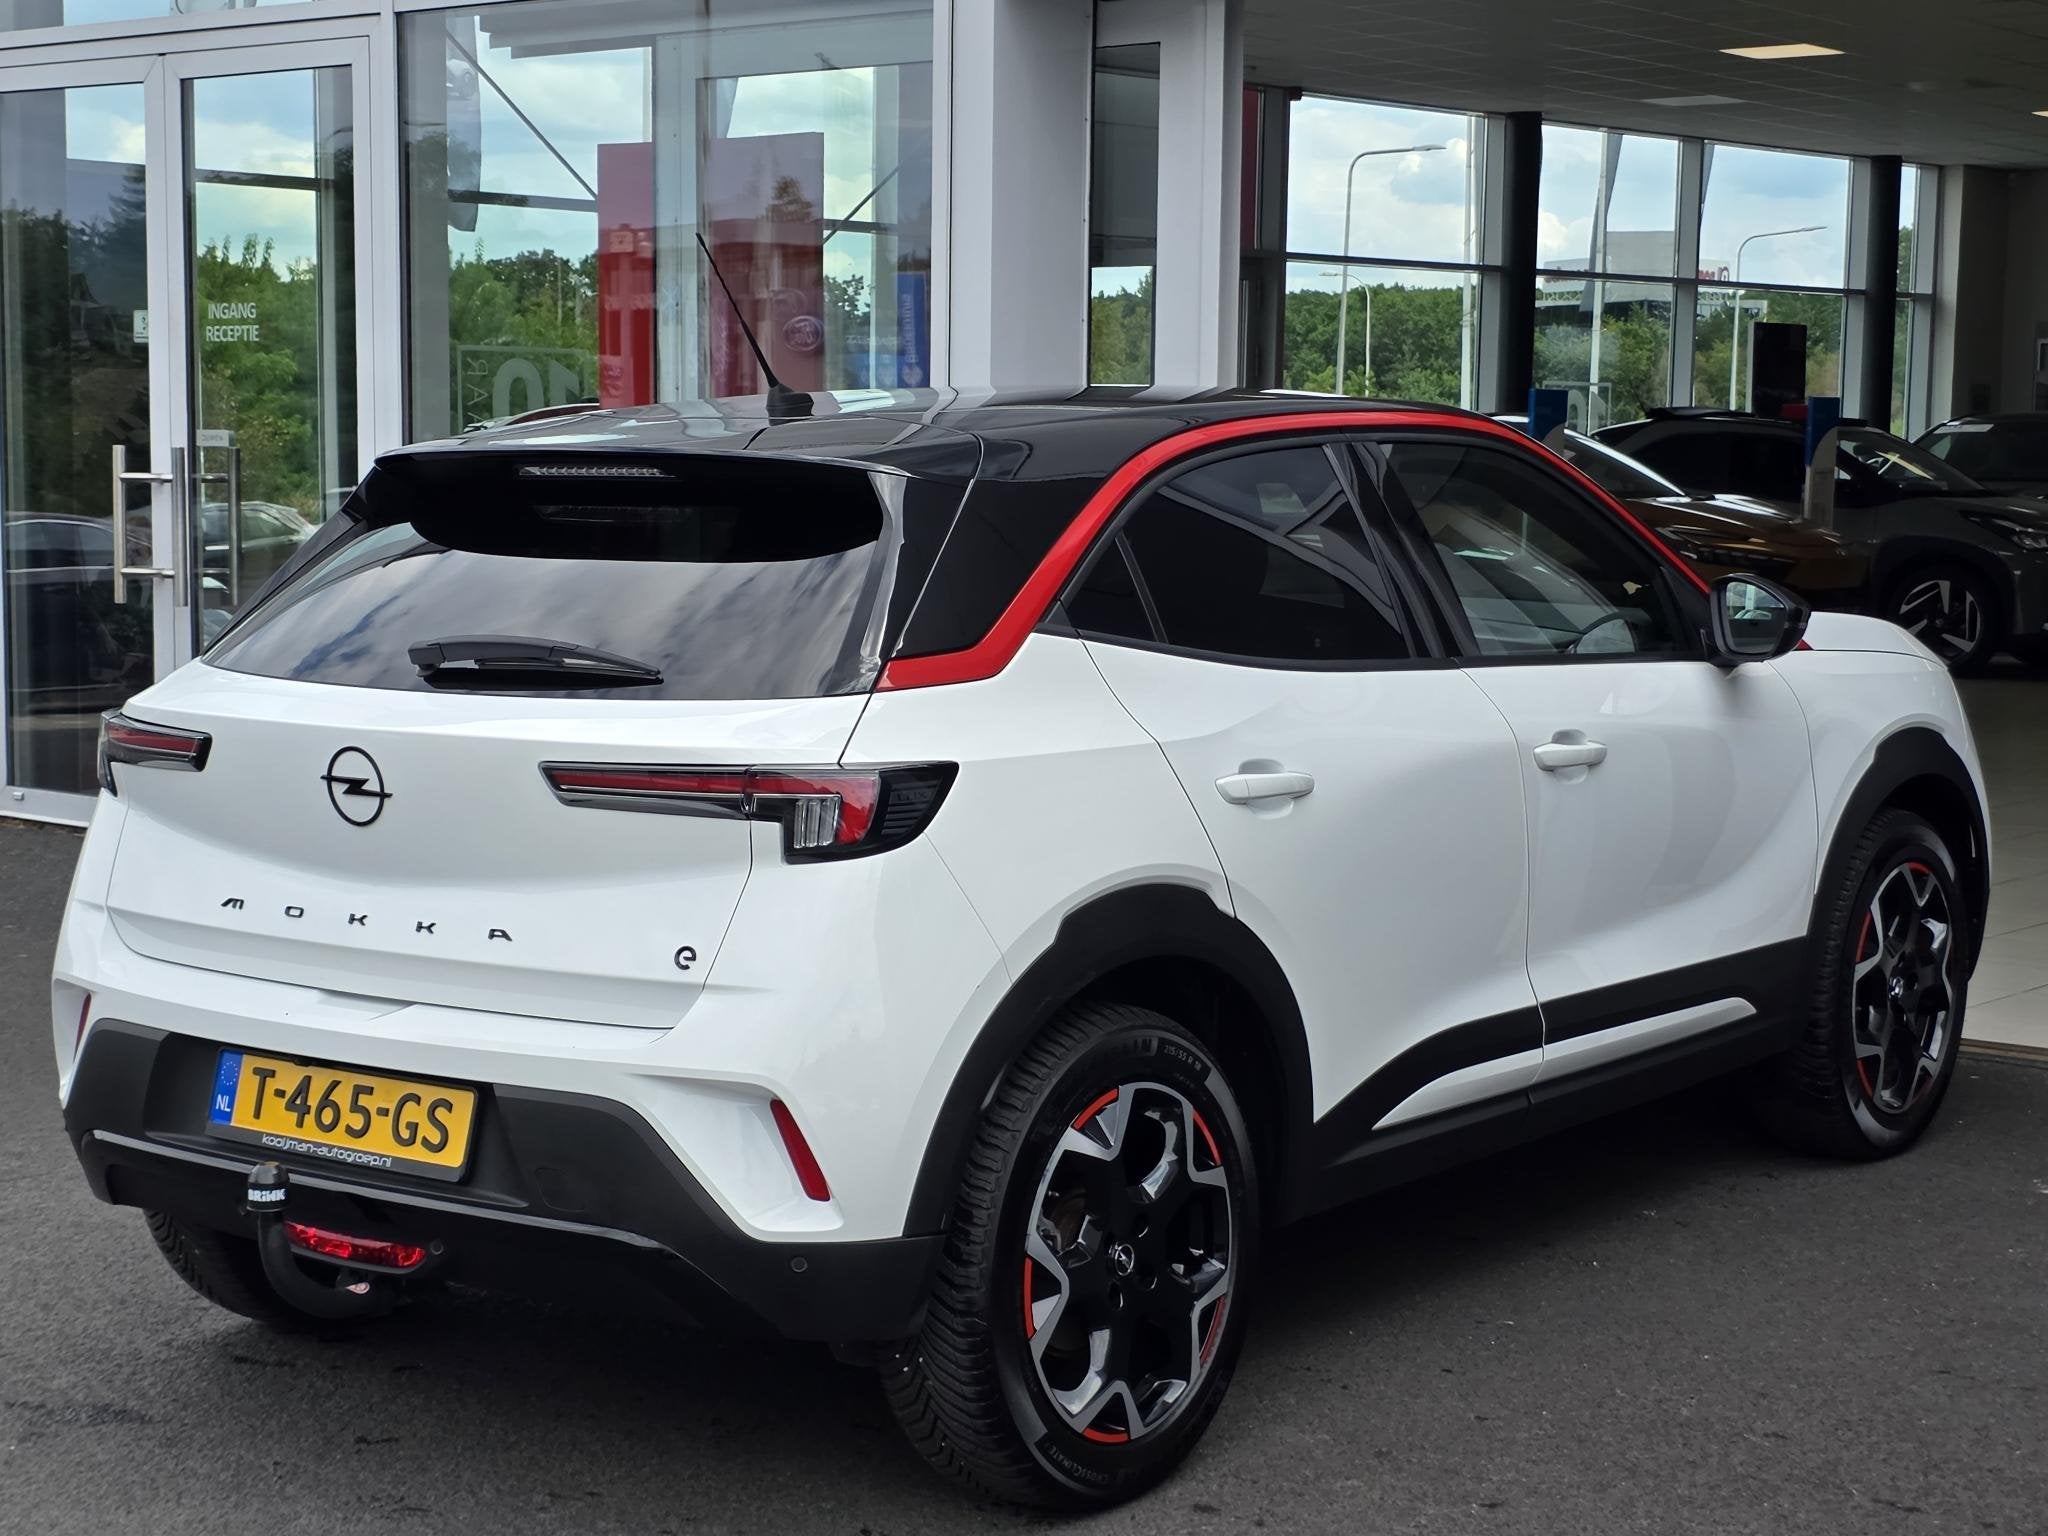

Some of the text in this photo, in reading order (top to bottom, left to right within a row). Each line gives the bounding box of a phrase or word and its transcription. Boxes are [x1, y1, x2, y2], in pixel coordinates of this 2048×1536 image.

[208, 303, 257, 319] INGANG
[206, 325, 260, 341] RECEPTIE
[220, 897, 513, 942] MOKKA
[674, 945, 697, 971] e
[215, 1094, 231, 1112] NL
[252, 1066, 454, 1154] T-465-GS
[261, 1133, 392, 1168] kooijman-autogroep.nl
